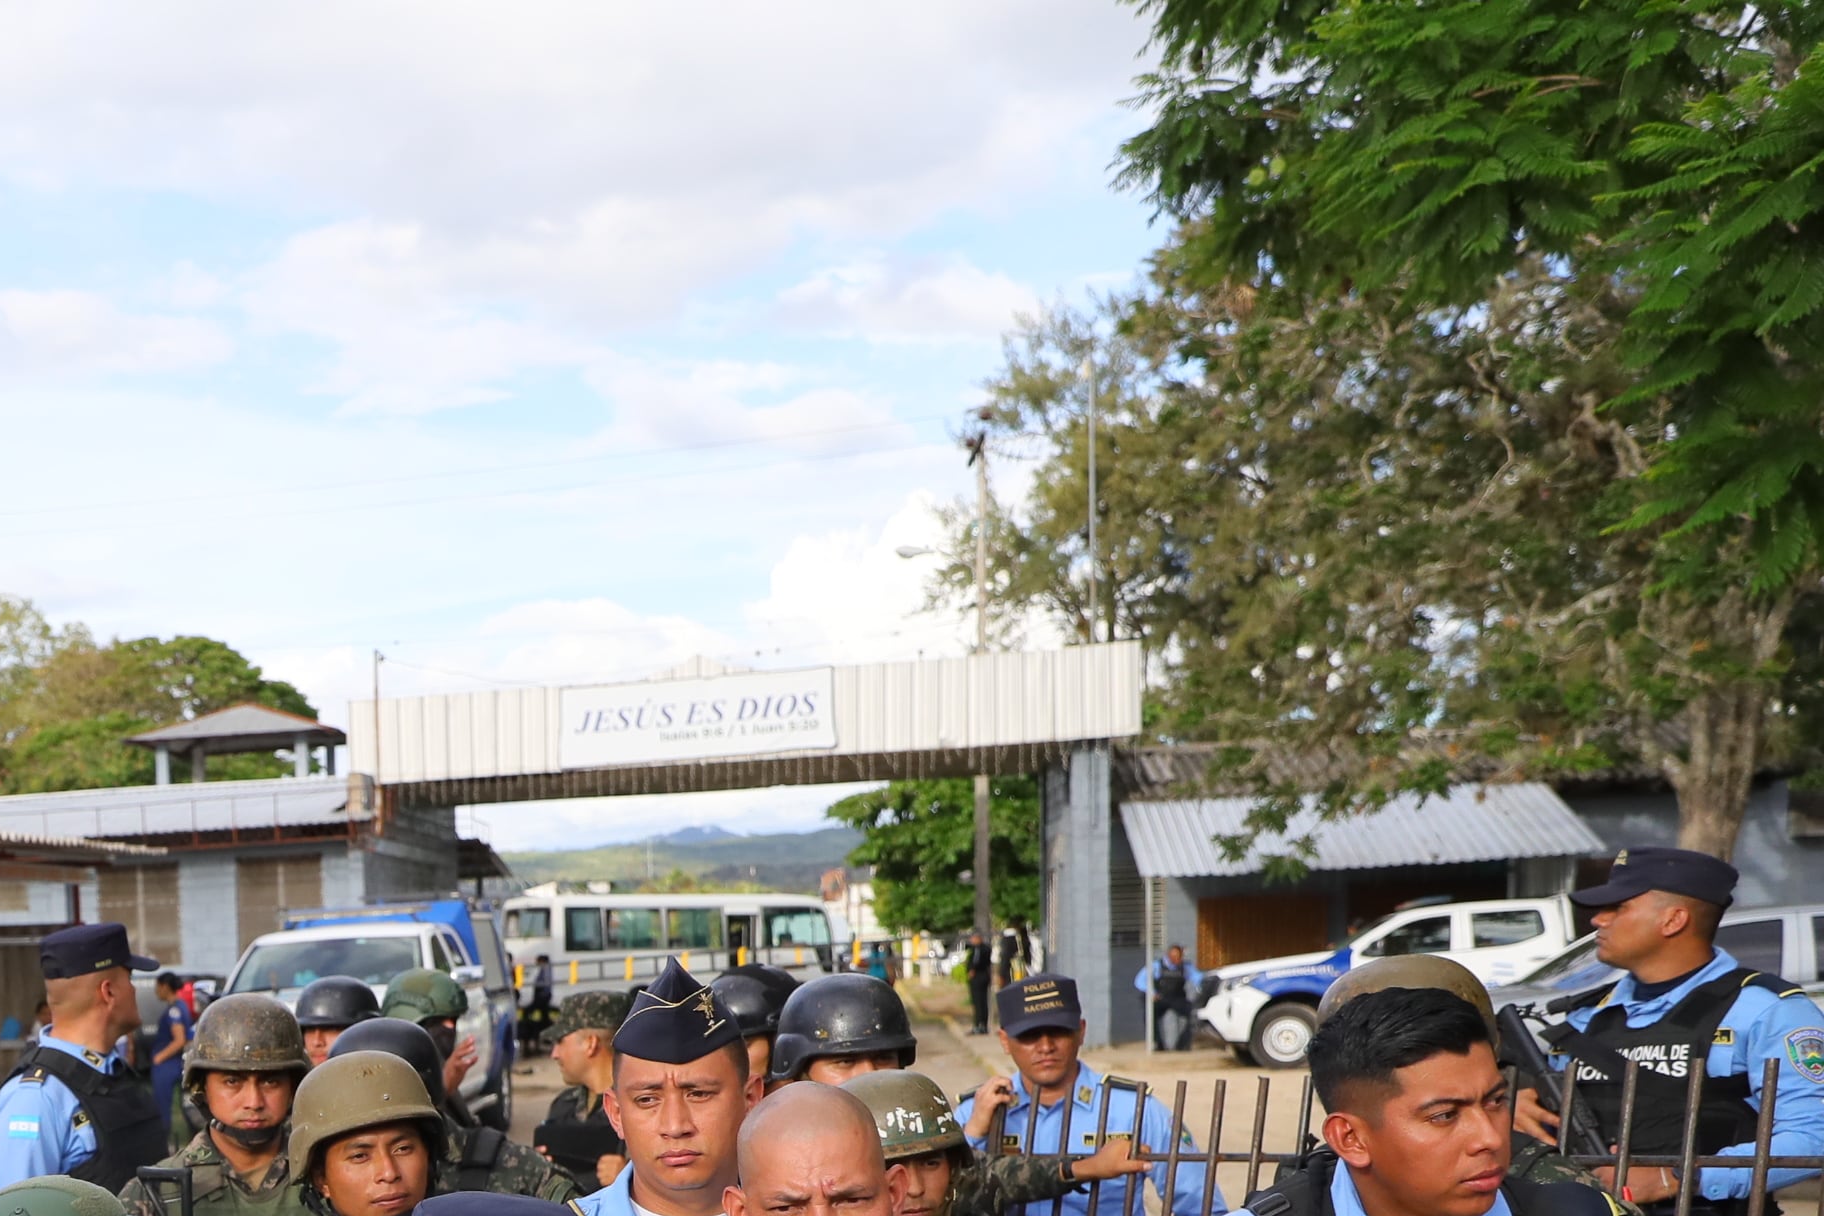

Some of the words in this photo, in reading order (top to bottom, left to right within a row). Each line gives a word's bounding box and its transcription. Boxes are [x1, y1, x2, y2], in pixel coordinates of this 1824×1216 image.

[574, 698, 675, 734] JESÚS
[686, 700, 727, 726] ES
[737, 692, 819, 721] DIOS
[1670, 1044, 1690, 1061] DE
